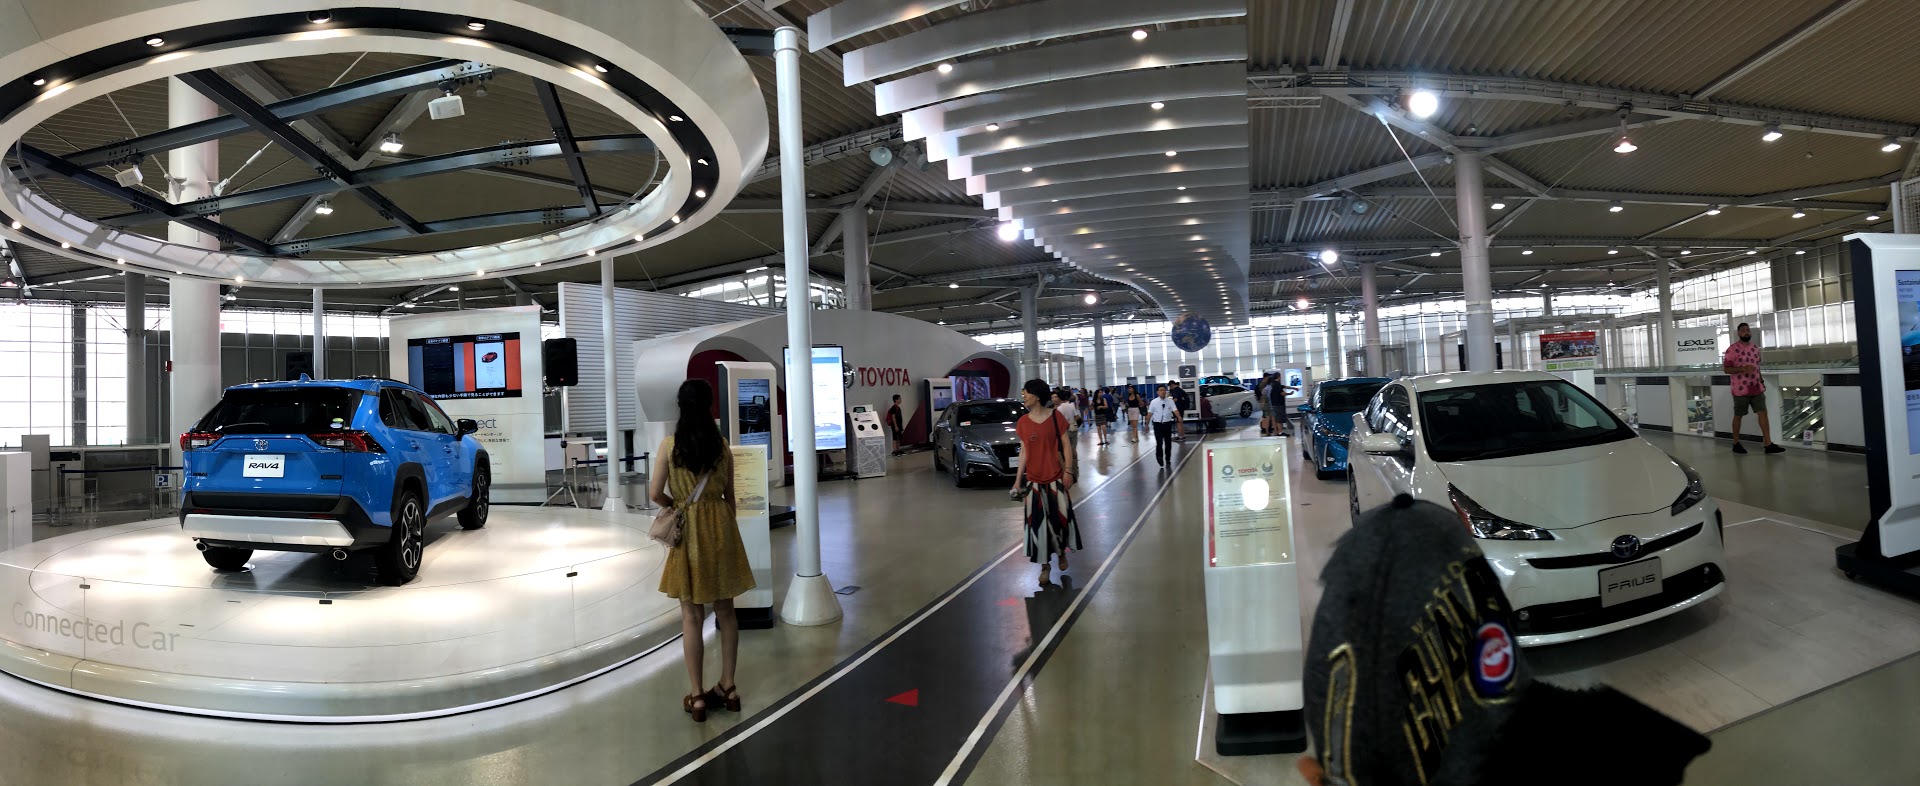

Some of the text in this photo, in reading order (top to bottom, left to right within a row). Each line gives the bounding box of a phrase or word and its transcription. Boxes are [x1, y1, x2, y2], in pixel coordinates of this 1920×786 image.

[1677, 338, 1715, 347] LEXUS
[858, 366, 911, 387] TOYOTA
[1184, 368, 1191, 376] 2
[476, 418, 497, 429] ect
[248, 462, 280, 470] RAV4
[1607, 573, 1656, 593] PRIUS
[11, 601, 181, 652] Connected Car
